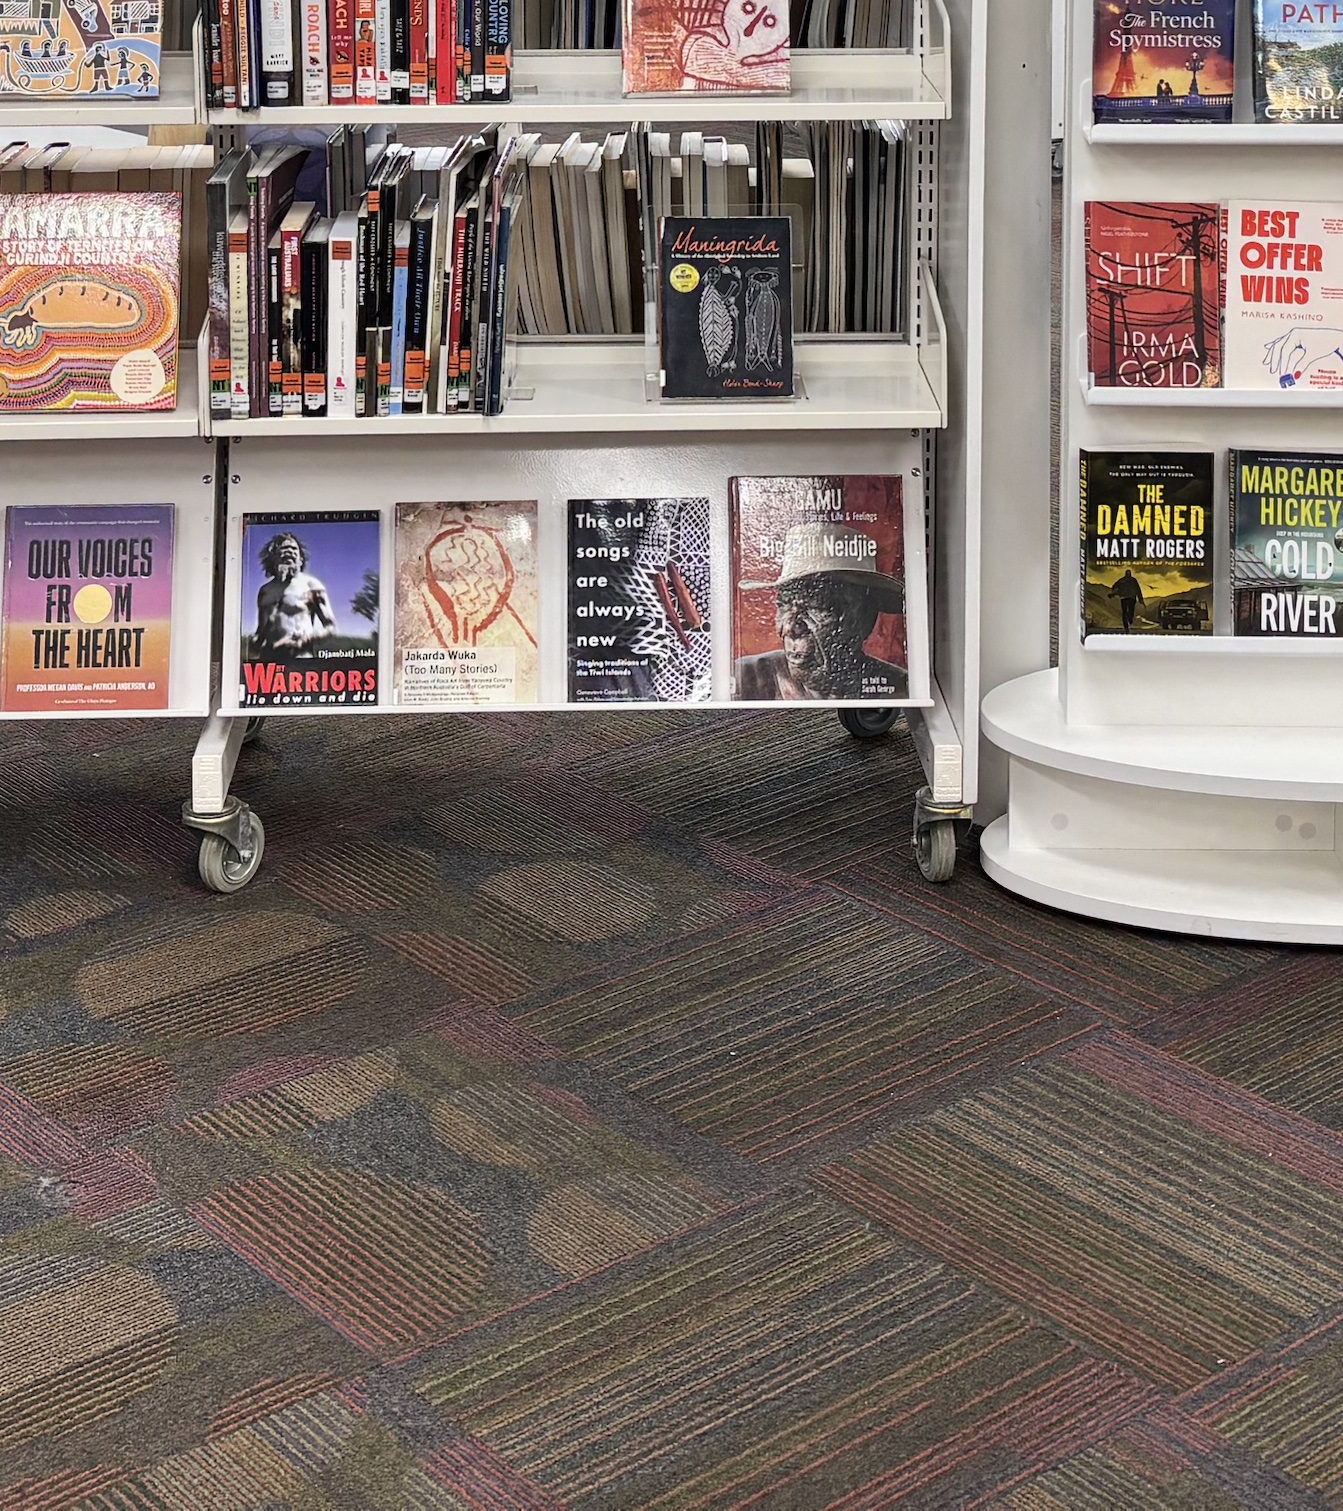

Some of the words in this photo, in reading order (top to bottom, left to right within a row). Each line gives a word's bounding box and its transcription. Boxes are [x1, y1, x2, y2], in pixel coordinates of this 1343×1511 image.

[499, 0, 509, 44] LOVING
[1150, 11, 1215, 29] French
[1109, 30, 1221, 53] Spymistress
[1241, 209, 1300, 239] BEST
[671, 226, 780, 264] Maningrida
[1239, 241, 1323, 272] OFFER
[6, 253, 70, 265] GURINDJI
[1096, 251, 1197, 287] SHIFT
[1240, 274, 1310, 305] WINS
[1241, 311, 1276, 320] MARISA
[1280, 312, 1324, 322] KASHINO
[1118, 360, 1205, 388] GOLD
[575, 513, 608, 529] The
[614, 512, 644, 528] old
[1097, 505, 1205, 537] DAMNED
[27, 539, 71, 580] OUR
[78, 537, 153, 579] VOICES
[576, 545, 630, 562] songs
[823, 534, 877, 561] Neidjie
[1146, 538, 1205, 559] ROGERS
[1265, 538, 1334, 580] COLD
[576, 575, 608, 587] are
[576, 602, 645, 621] always
[1261, 593, 1336, 634] RIVER
[32, 629, 71, 669] THE
[76, 628, 145, 669] HEART
[576, 634, 617, 647] new
[404, 664, 426, 675] (Too
[430, 664, 457, 675] Many
[459, 663, 498, 675] Stories)
[405, 651, 445, 661] Jakarda
[448, 650, 476, 660] Wuka
[243, 663, 376, 694] WARRIORS
[274, 693, 312, 704] down
[318, 692, 346, 703] and
[353, 691, 376, 703] die
